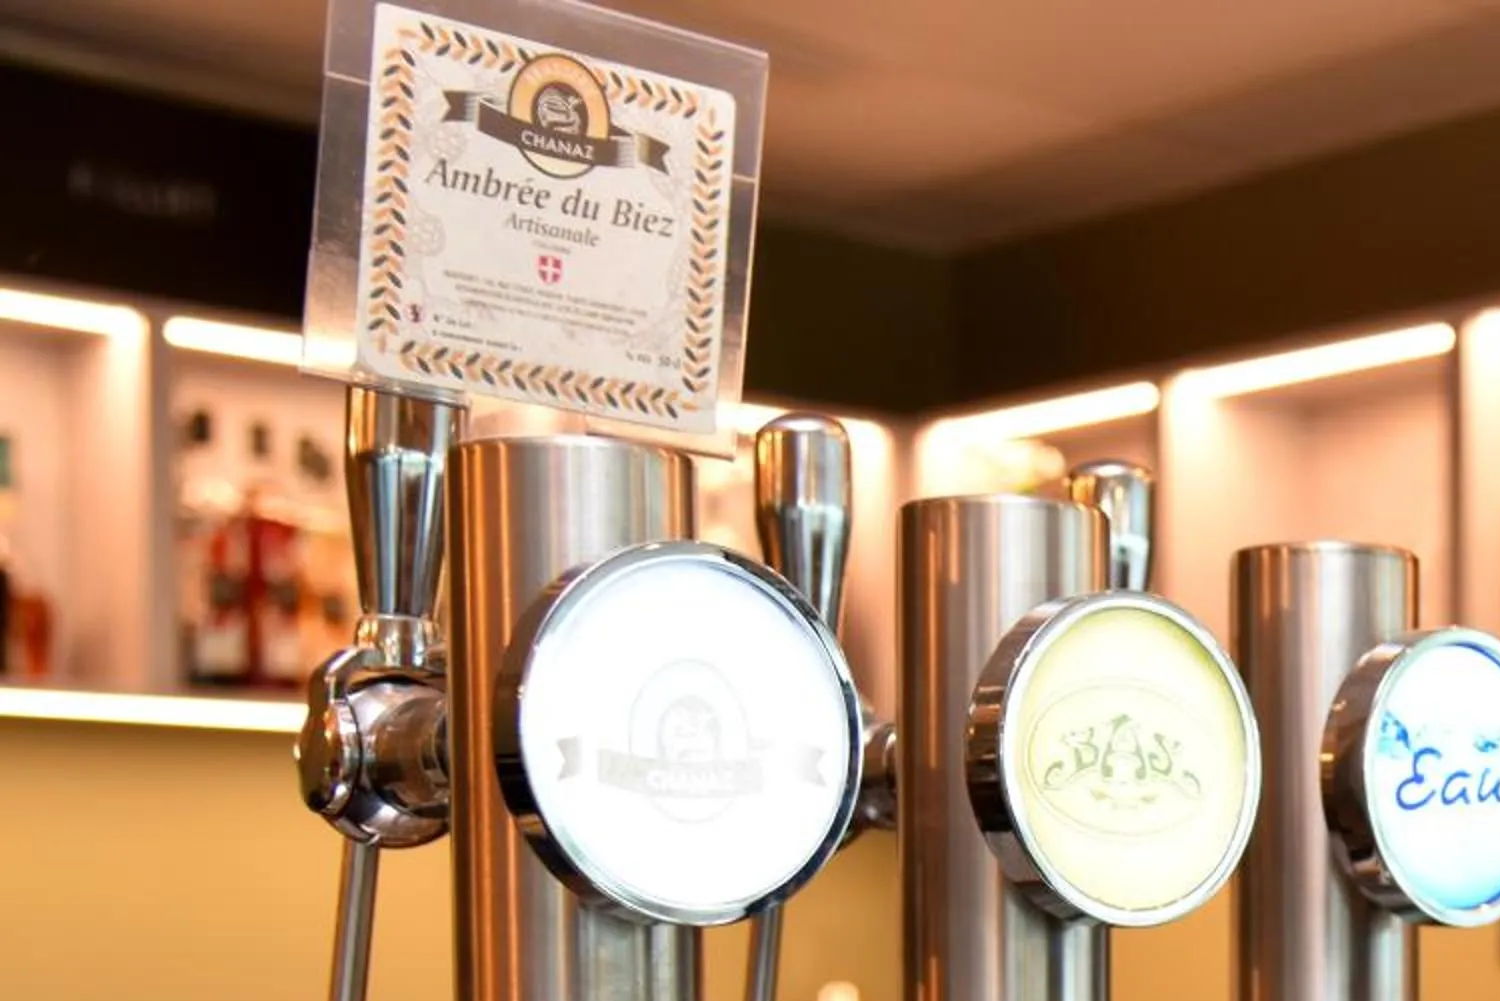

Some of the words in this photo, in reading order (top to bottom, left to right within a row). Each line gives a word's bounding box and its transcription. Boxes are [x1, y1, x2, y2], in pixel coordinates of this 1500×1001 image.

[520, 129, 596, 161] CHANAZ
[424, 157, 552, 211] Ambrée
[561, 184, 601, 222] du
[611, 198, 676, 240] Biez
[504, 211, 601, 249] Artisanale
